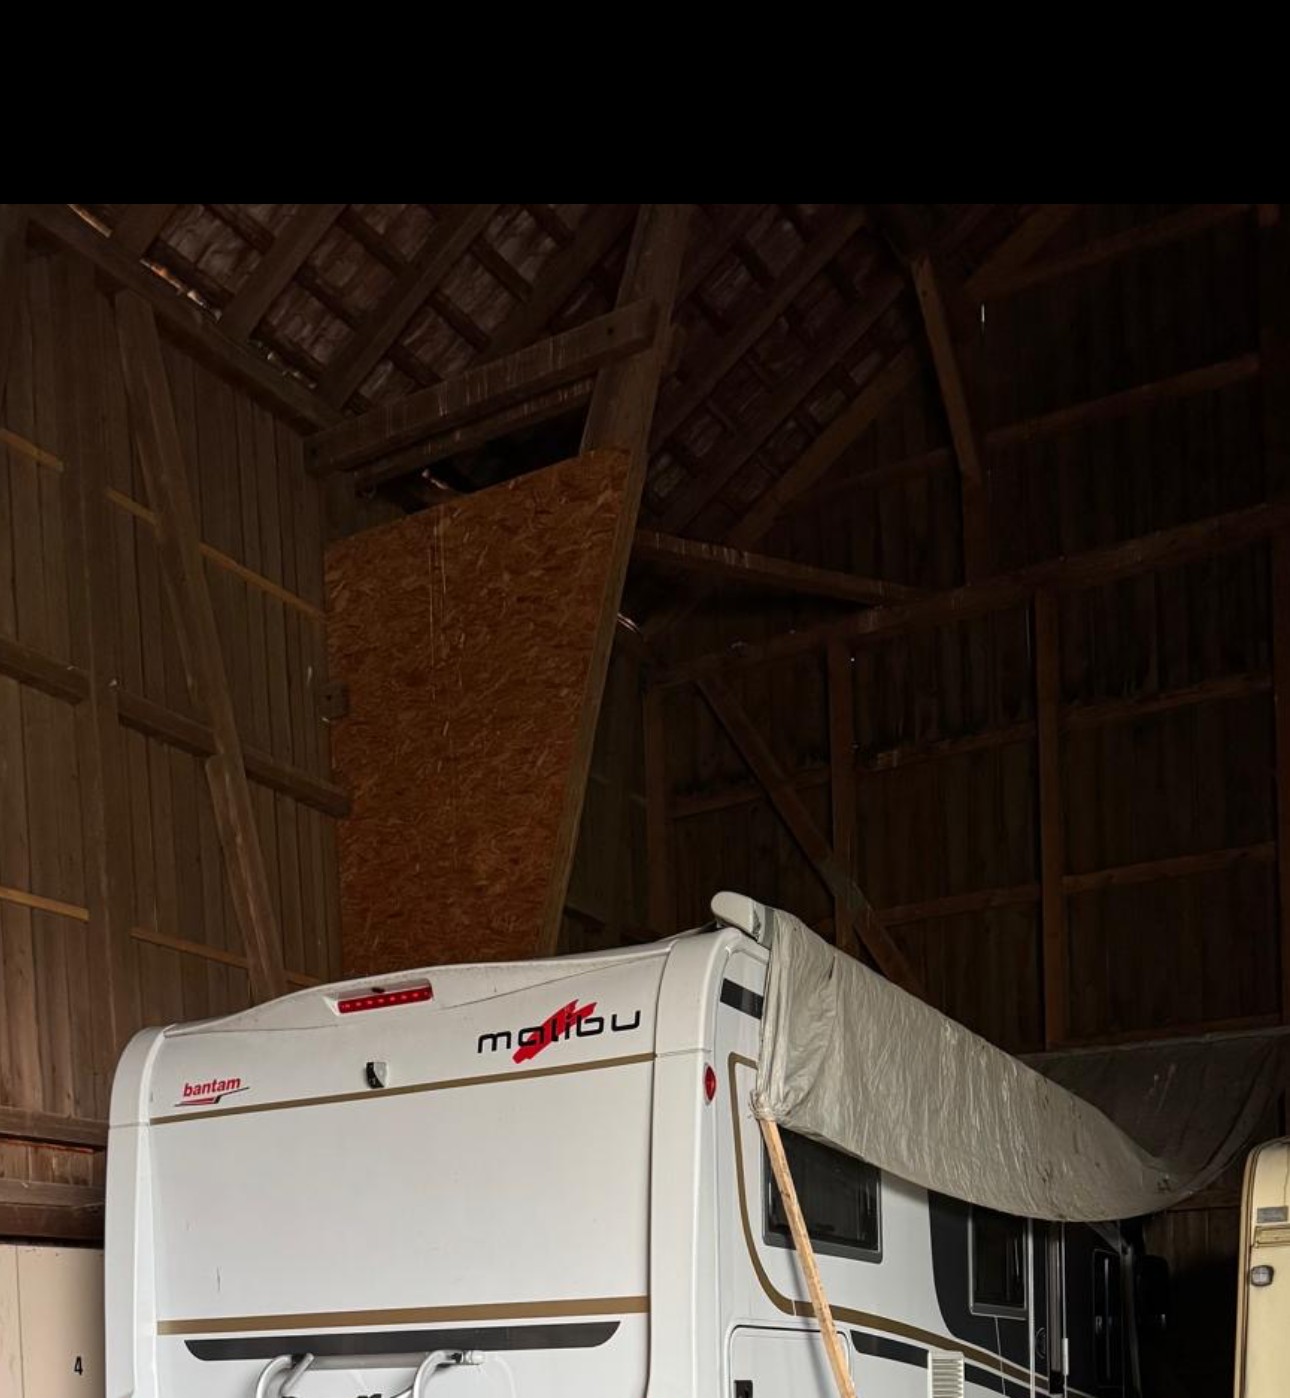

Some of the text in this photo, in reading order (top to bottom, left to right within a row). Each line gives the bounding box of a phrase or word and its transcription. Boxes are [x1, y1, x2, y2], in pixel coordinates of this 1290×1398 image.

[477, 1010, 641, 1054] malibu
[183, 1078, 241, 1097] bantam
[74, 1356, 83, 1376] 4
